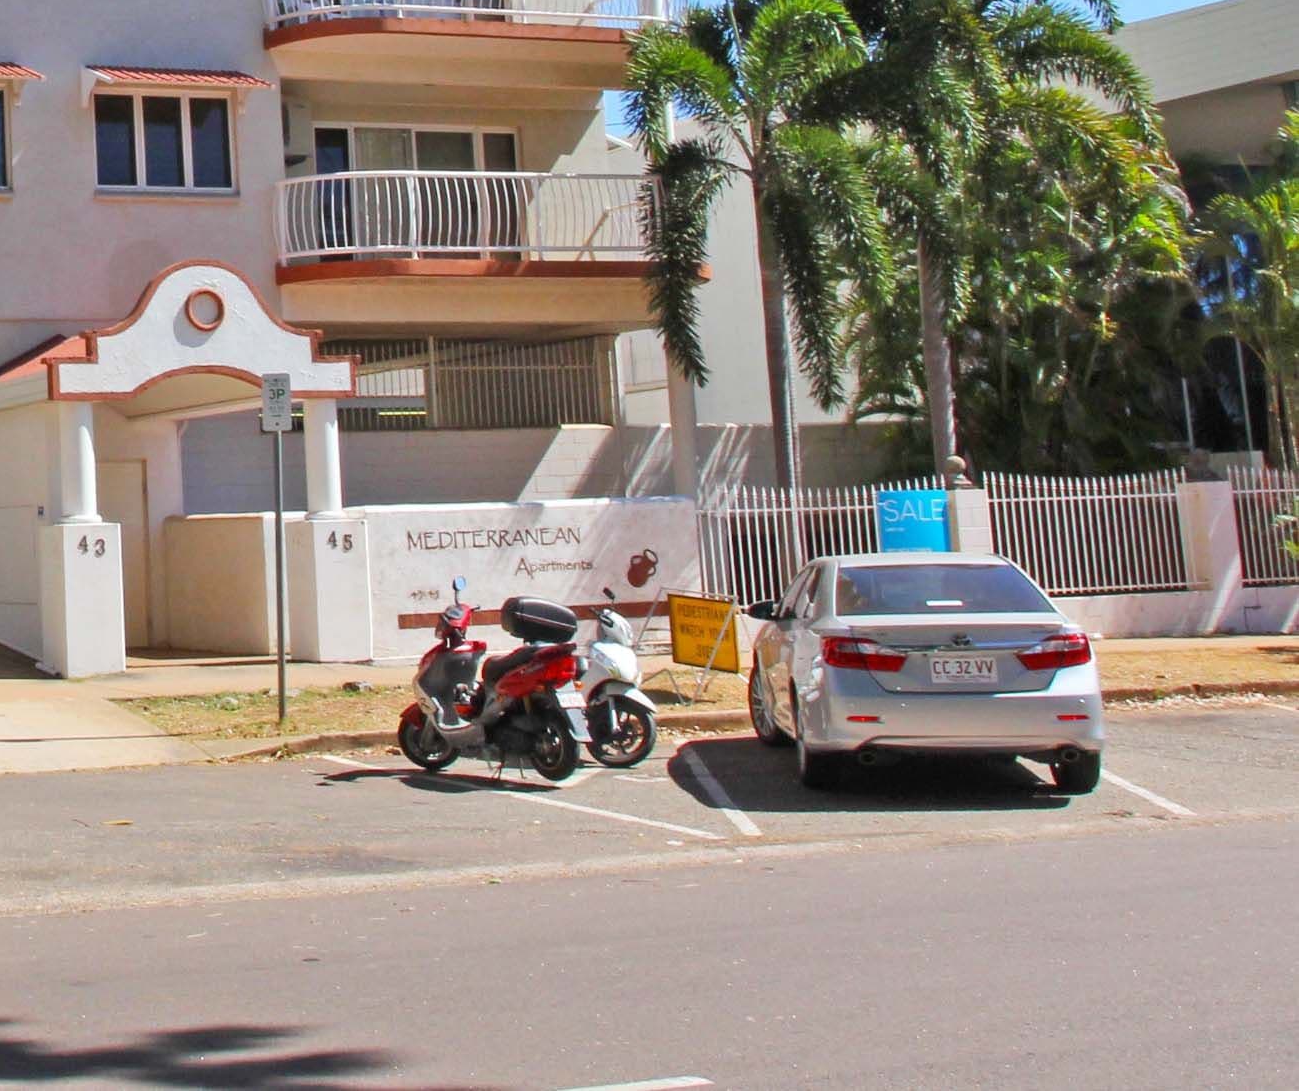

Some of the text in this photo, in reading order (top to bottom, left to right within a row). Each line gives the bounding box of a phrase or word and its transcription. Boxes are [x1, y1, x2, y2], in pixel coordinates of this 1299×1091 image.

[268, 388, 286, 400] 3P
[882, 498, 946, 522] SALE
[78, 534, 106, 558] 43
[327, 530, 353, 552] 45
[406, 526, 582, 551] MEDITERRANEAN
[514, 557, 595, 579] Apartments
[932, 660, 994, 675] CC 32 VV
